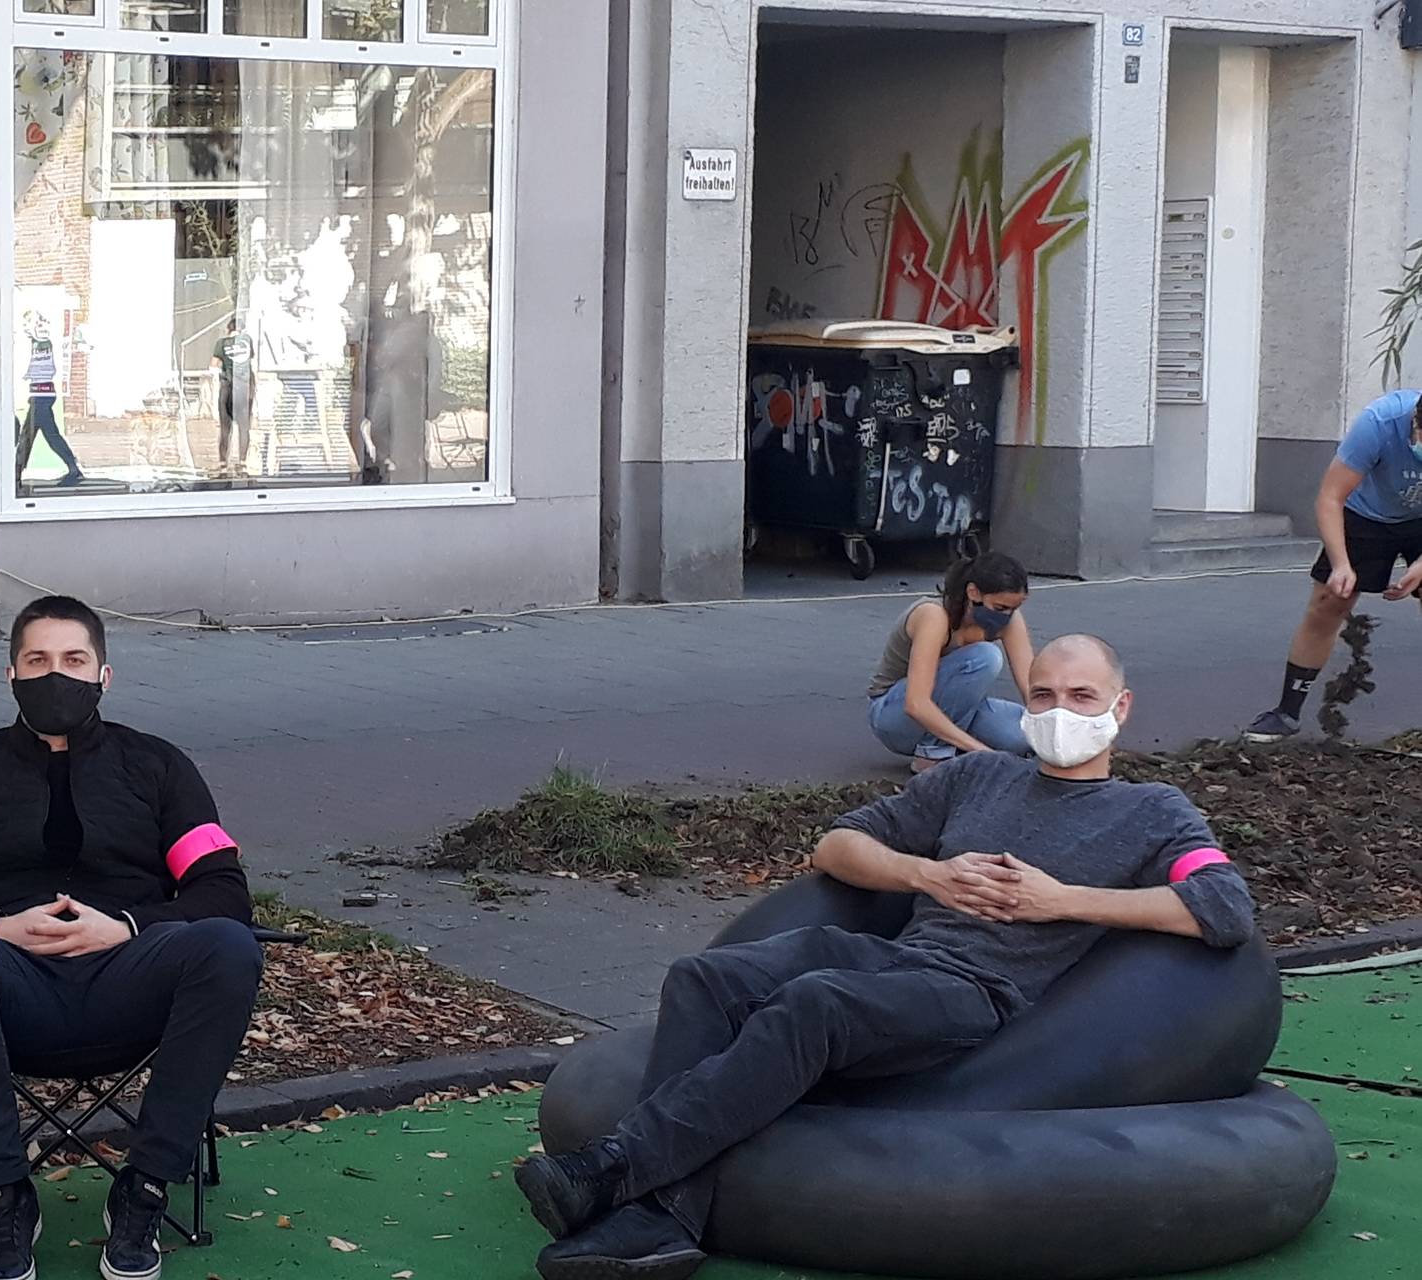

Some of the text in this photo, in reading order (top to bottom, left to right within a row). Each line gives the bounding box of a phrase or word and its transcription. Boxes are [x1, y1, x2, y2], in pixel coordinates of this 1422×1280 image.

[1126, 27, 1141, 41] 82
[689, 157, 732, 171] Ausfahrt
[685, 175, 735, 191] freihalten!
